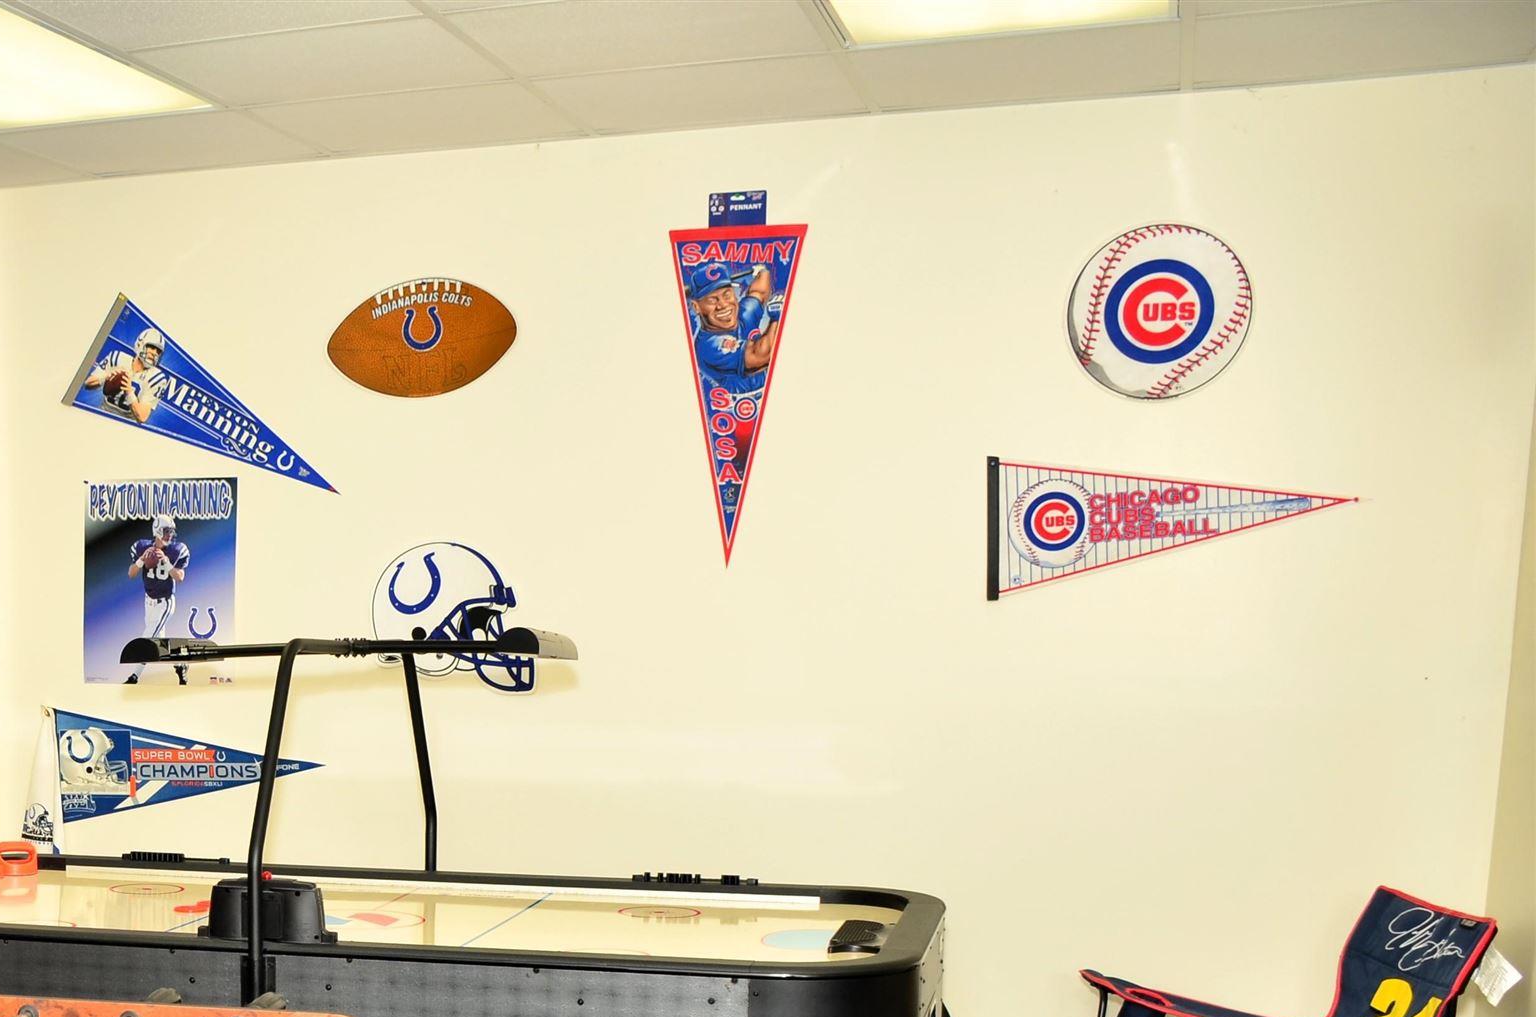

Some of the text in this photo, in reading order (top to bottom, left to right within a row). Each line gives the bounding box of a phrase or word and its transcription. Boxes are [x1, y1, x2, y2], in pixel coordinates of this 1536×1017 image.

[729, 203, 762, 211] PENNANT
[681, 240, 795, 265] SAMMY
[371, 291, 473, 320] INDIANAPOLIS COLTS
[162, 375, 275, 464] Manning
[190, 386, 260, 440] PEYTON
[88, 480, 233, 520] PEYTON MANNING
[1089, 485, 1201, 510] CHICAGO
[1089, 505, 1156, 526] CUBS
[1089, 518, 1218, 543] BASEBALL
[134, 751, 211, 760] SUPER BOWL
[139, 763, 258, 779] CHAMPIONS
